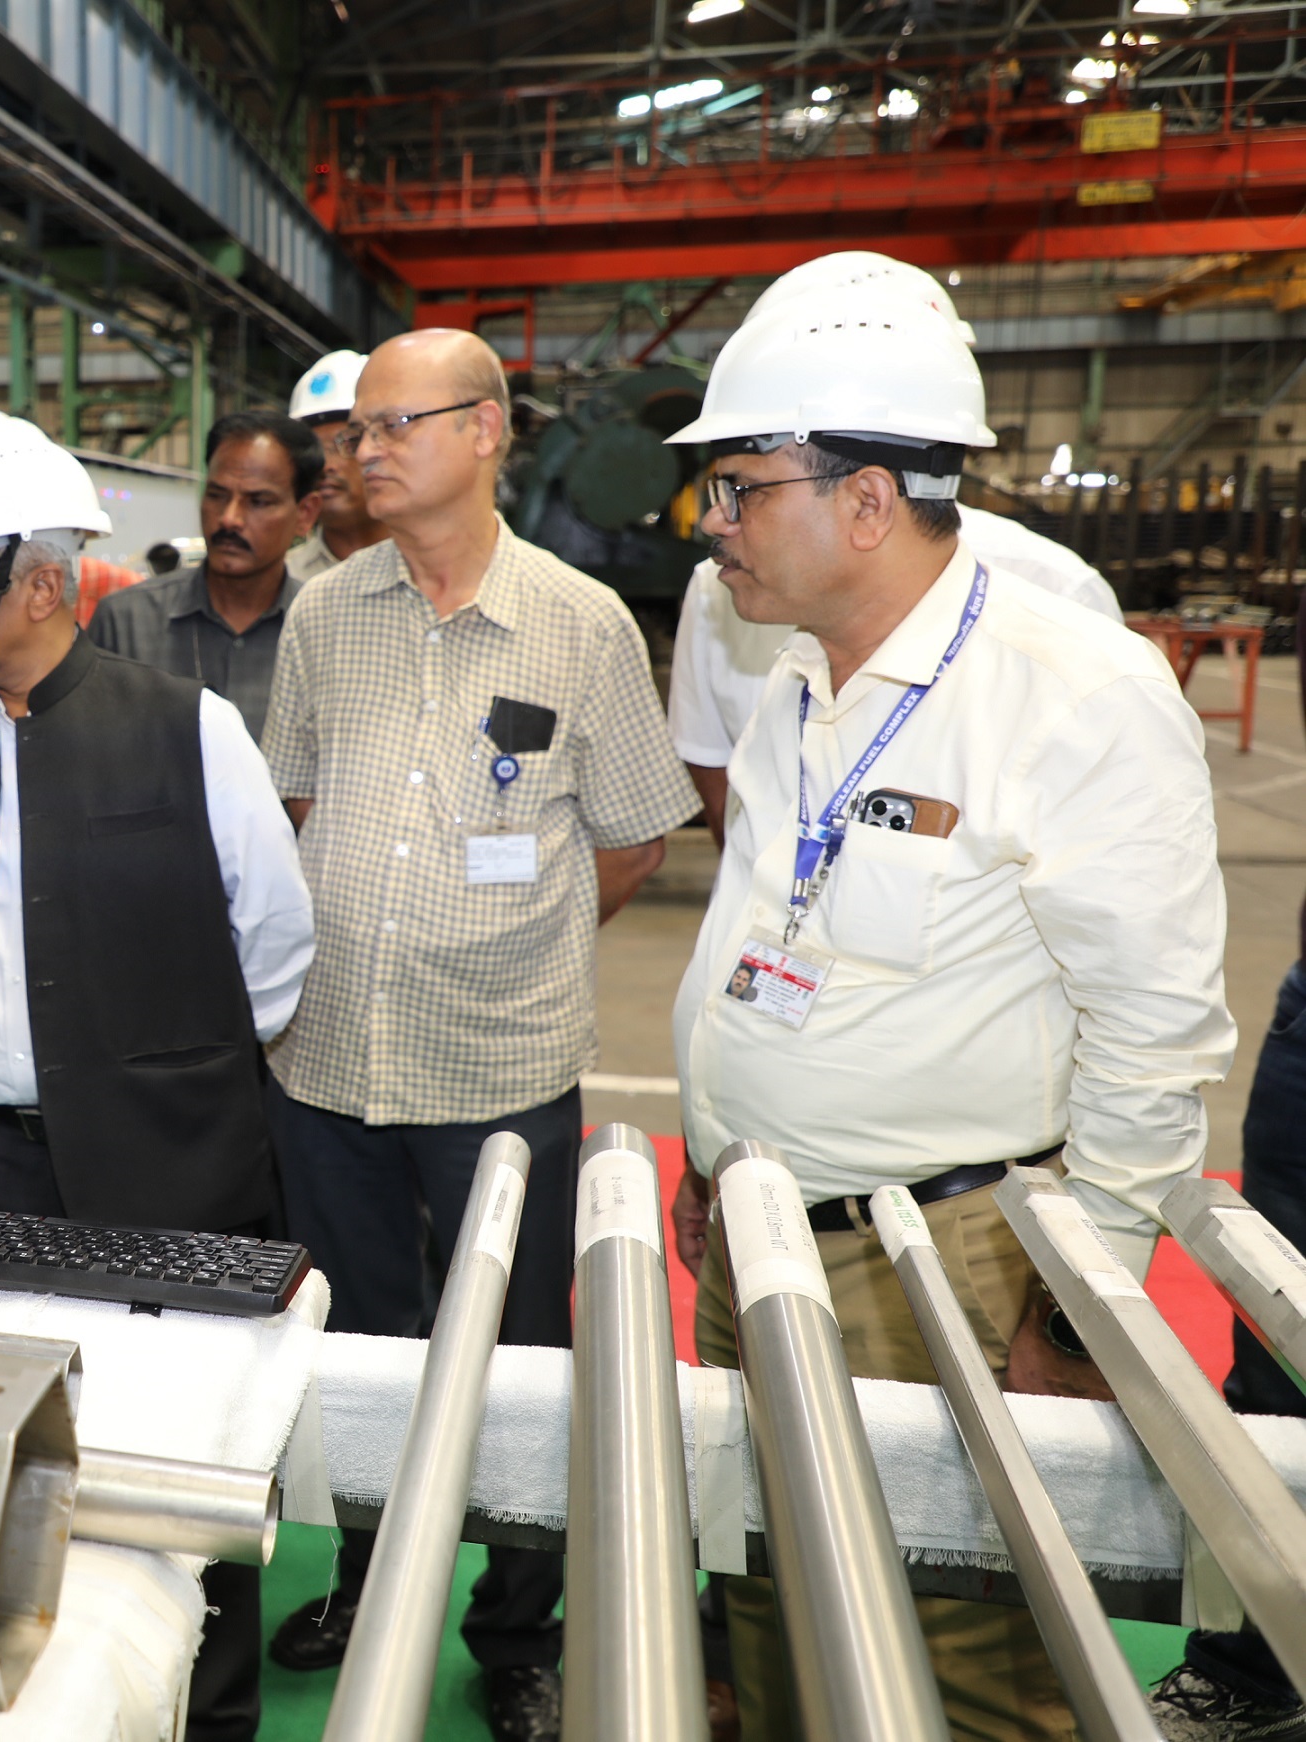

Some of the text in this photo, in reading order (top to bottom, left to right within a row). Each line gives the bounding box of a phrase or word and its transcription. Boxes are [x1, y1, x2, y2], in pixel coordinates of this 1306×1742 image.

[858, 743, 882, 772] FUEL
[879, 690, 921, 743] COMPLEX
[759, 1183, 775, 1201] 60mm
[763, 1201, 780, 1211] OD
[766, 1216, 783, 1238] 0.8mm
[770, 1239, 789, 1251] WT
